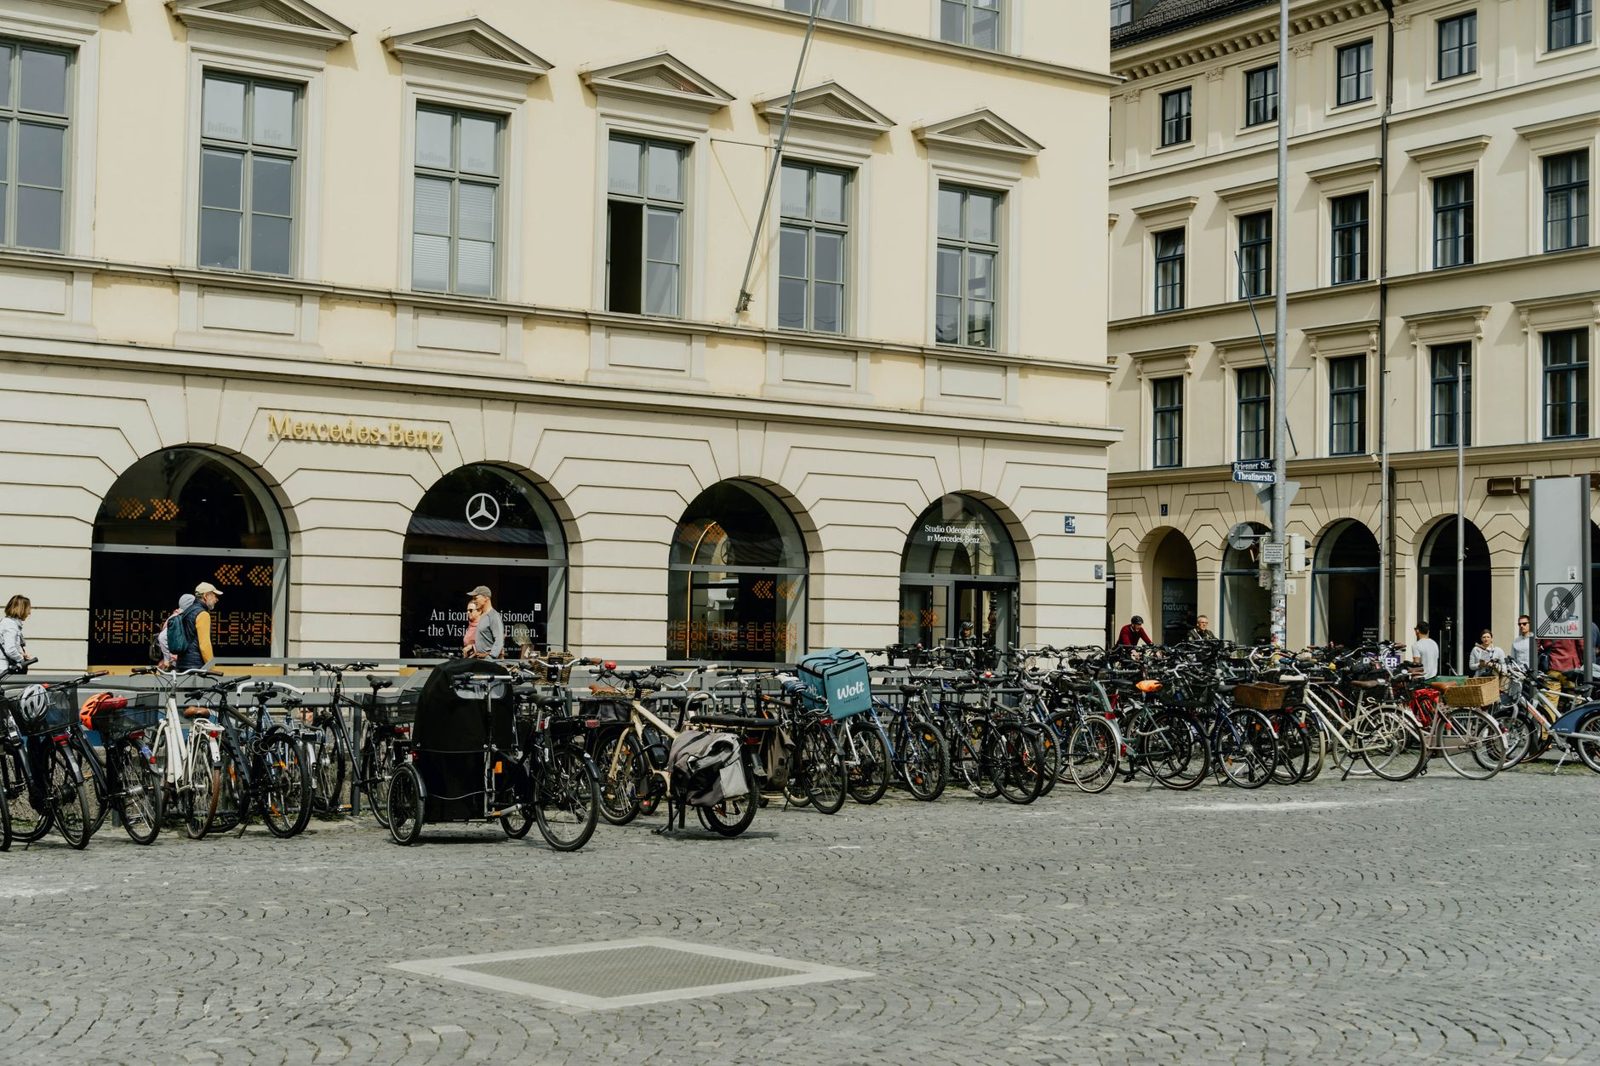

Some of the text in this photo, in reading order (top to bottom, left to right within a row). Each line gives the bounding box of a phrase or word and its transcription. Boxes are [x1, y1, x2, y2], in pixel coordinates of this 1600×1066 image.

[268, 413, 443, 449] Mercedes-Benz
[924, 524, 983, 535] Studio Odeonsplatz
[933, 534, 980, 543] Mercedes-Benz
[94, 609, 154, 620] VISION
[430, 609, 445, 621] An
[500, 610, 535, 622] isioned
[94, 620, 154, 633] VISION
[427, 624, 444, 637] the
[446, 624, 468, 637] Visi
[503, 624, 539, 638] Eleven.
[94, 632, 153, 644] VISION
[837, 681, 865, 700] Wolt
